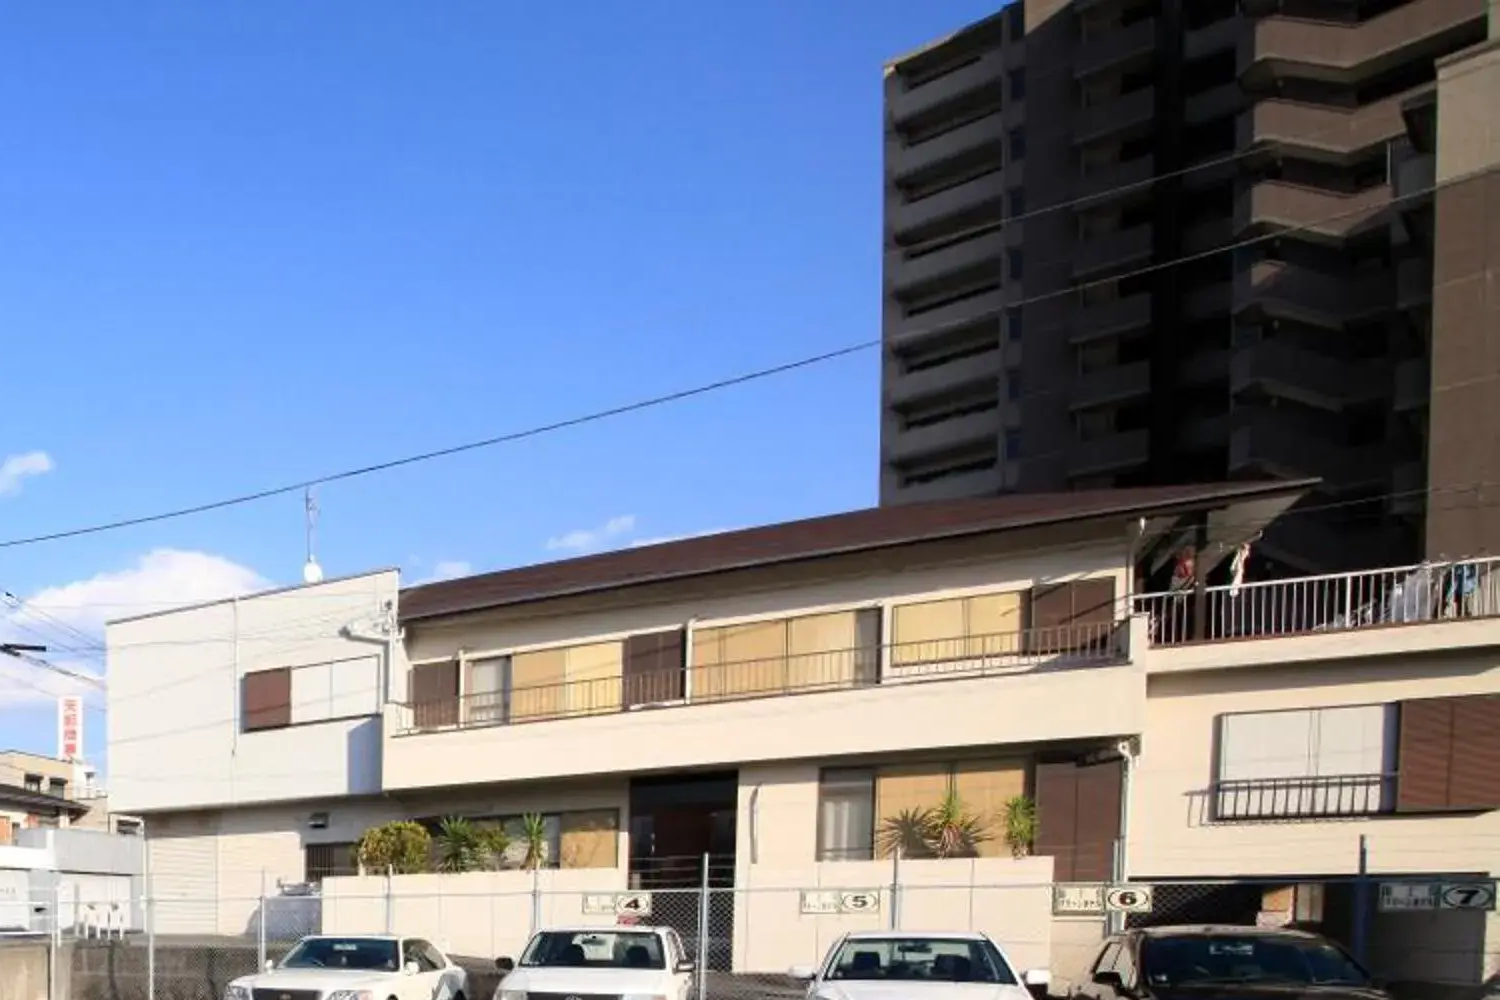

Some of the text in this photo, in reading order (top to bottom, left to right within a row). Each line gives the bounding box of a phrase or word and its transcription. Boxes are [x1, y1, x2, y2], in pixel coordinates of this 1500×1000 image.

[852, 895, 868, 908] 5
[1119, 892, 1137, 905] 6
[1456, 889, 1479, 904] 7
[624, 898, 640, 910] 4
